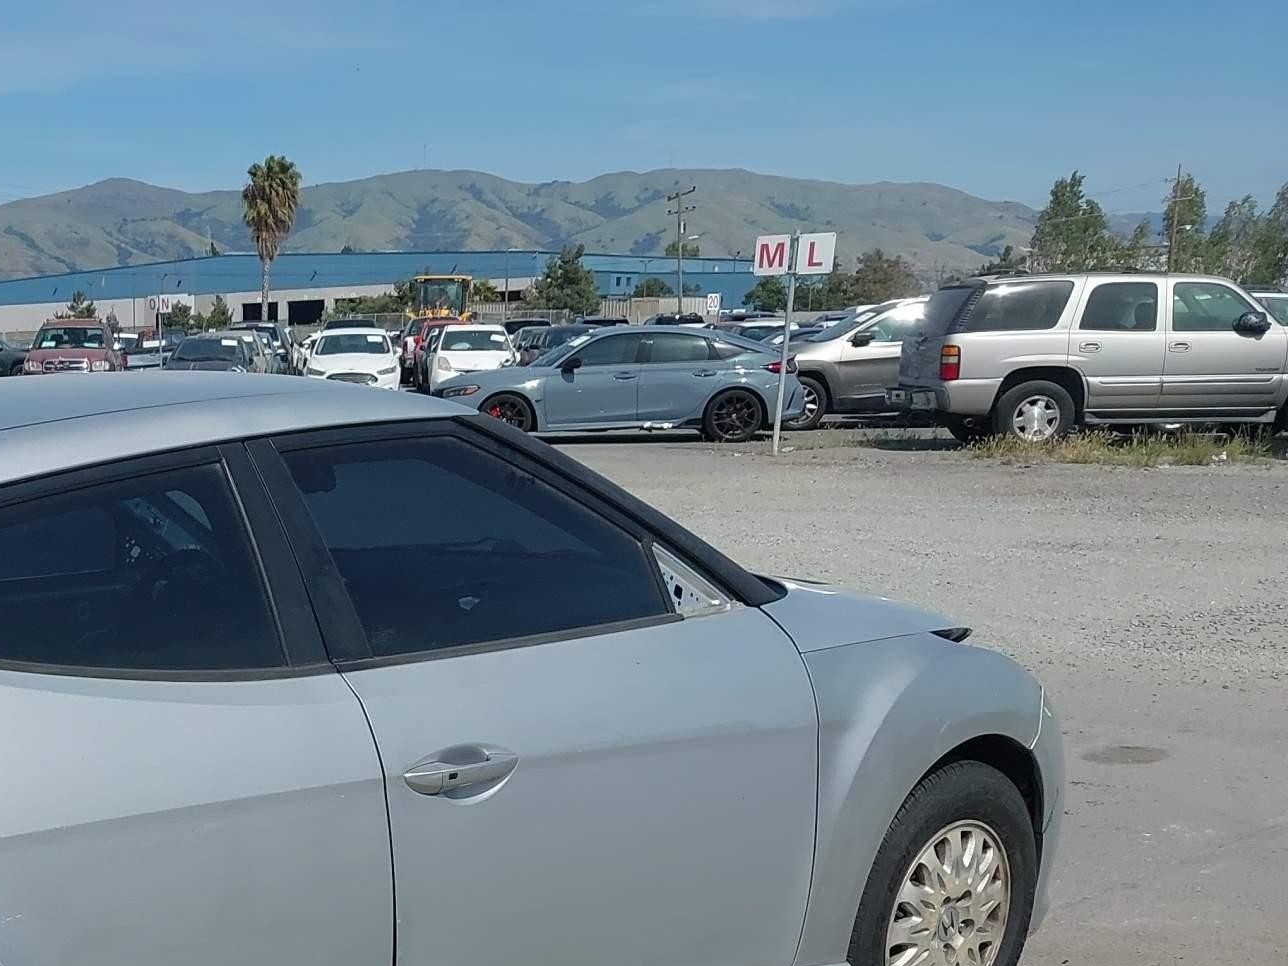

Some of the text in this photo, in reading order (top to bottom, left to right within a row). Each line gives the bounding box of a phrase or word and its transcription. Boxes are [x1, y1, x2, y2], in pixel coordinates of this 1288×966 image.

[758, 242, 785, 269] M
[807, 241, 823, 267] L
[161, 297, 169, 310] N
[708, 295, 719, 308] 20
